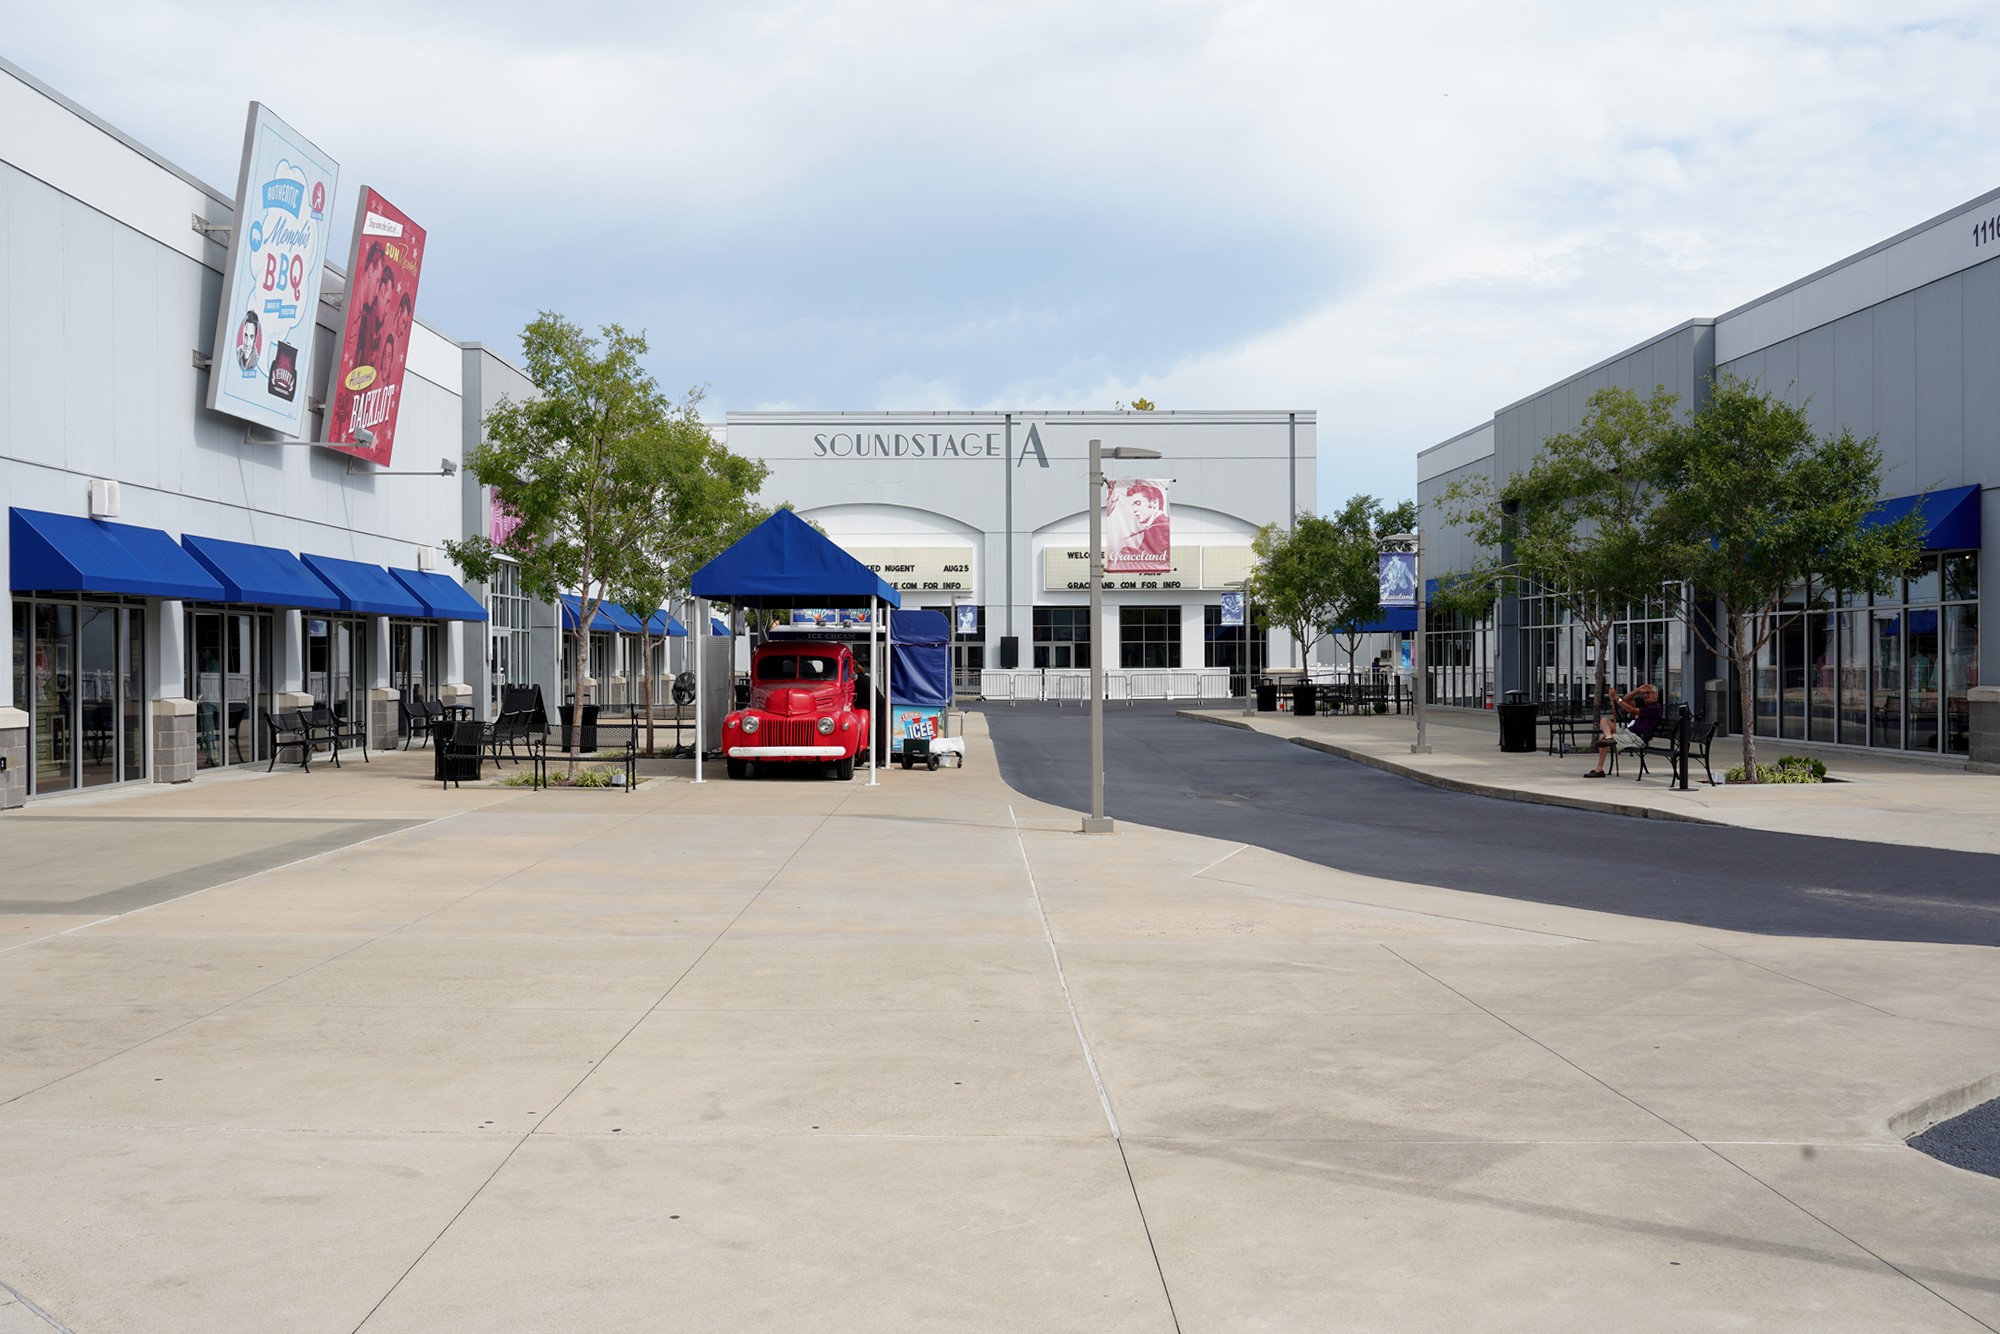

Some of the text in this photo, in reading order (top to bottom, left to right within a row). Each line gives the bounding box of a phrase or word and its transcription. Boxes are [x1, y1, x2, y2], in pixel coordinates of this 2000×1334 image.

[267, 184, 299, 209] AUTHENTIC
[263, 216, 310, 253] Memphis
[385, 241, 399, 263] SUN
[262, 252, 304, 302] BBQ
[348, 384, 395, 433] BACKLOT
[813, 422, 1050, 468] SOUNDSTAGE A
[1067, 551, 1105, 559] WELCE
[1109, 550, 1167, 566] Graceland
[908, 720, 934, 739] ICEE
